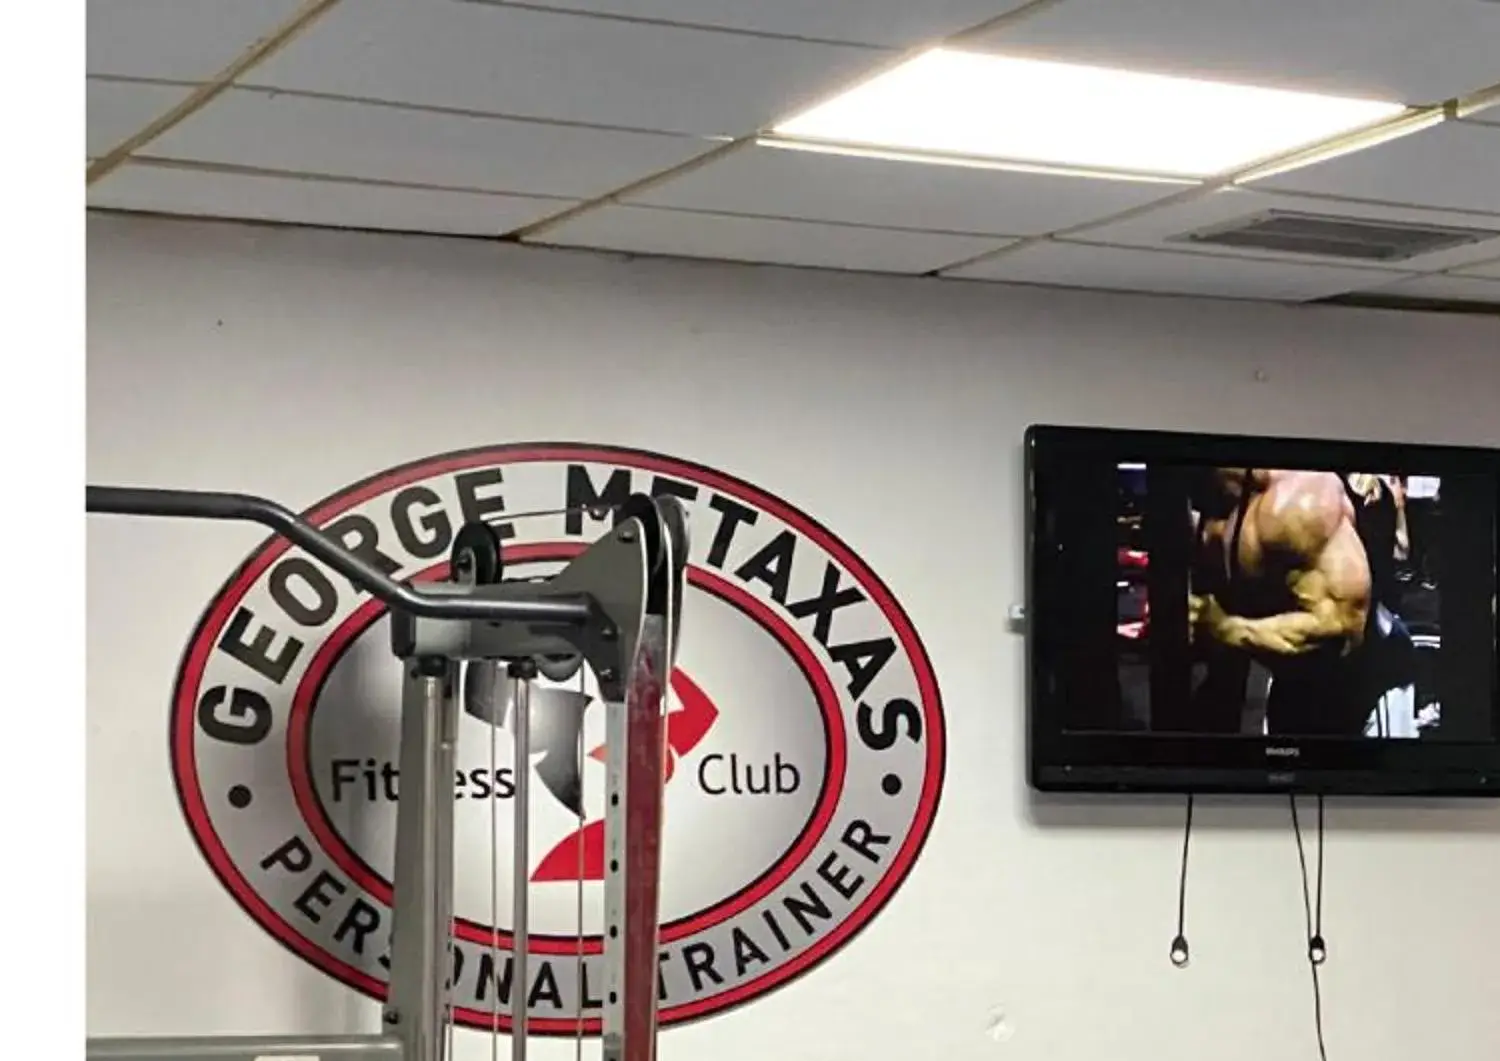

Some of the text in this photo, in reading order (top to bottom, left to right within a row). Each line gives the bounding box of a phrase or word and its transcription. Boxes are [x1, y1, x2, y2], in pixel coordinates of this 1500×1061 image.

[198, 468, 516, 746] GEORGE
[331, 752, 800, 801] Fitess Club
[260, 835, 603, 1009] PERNAL
